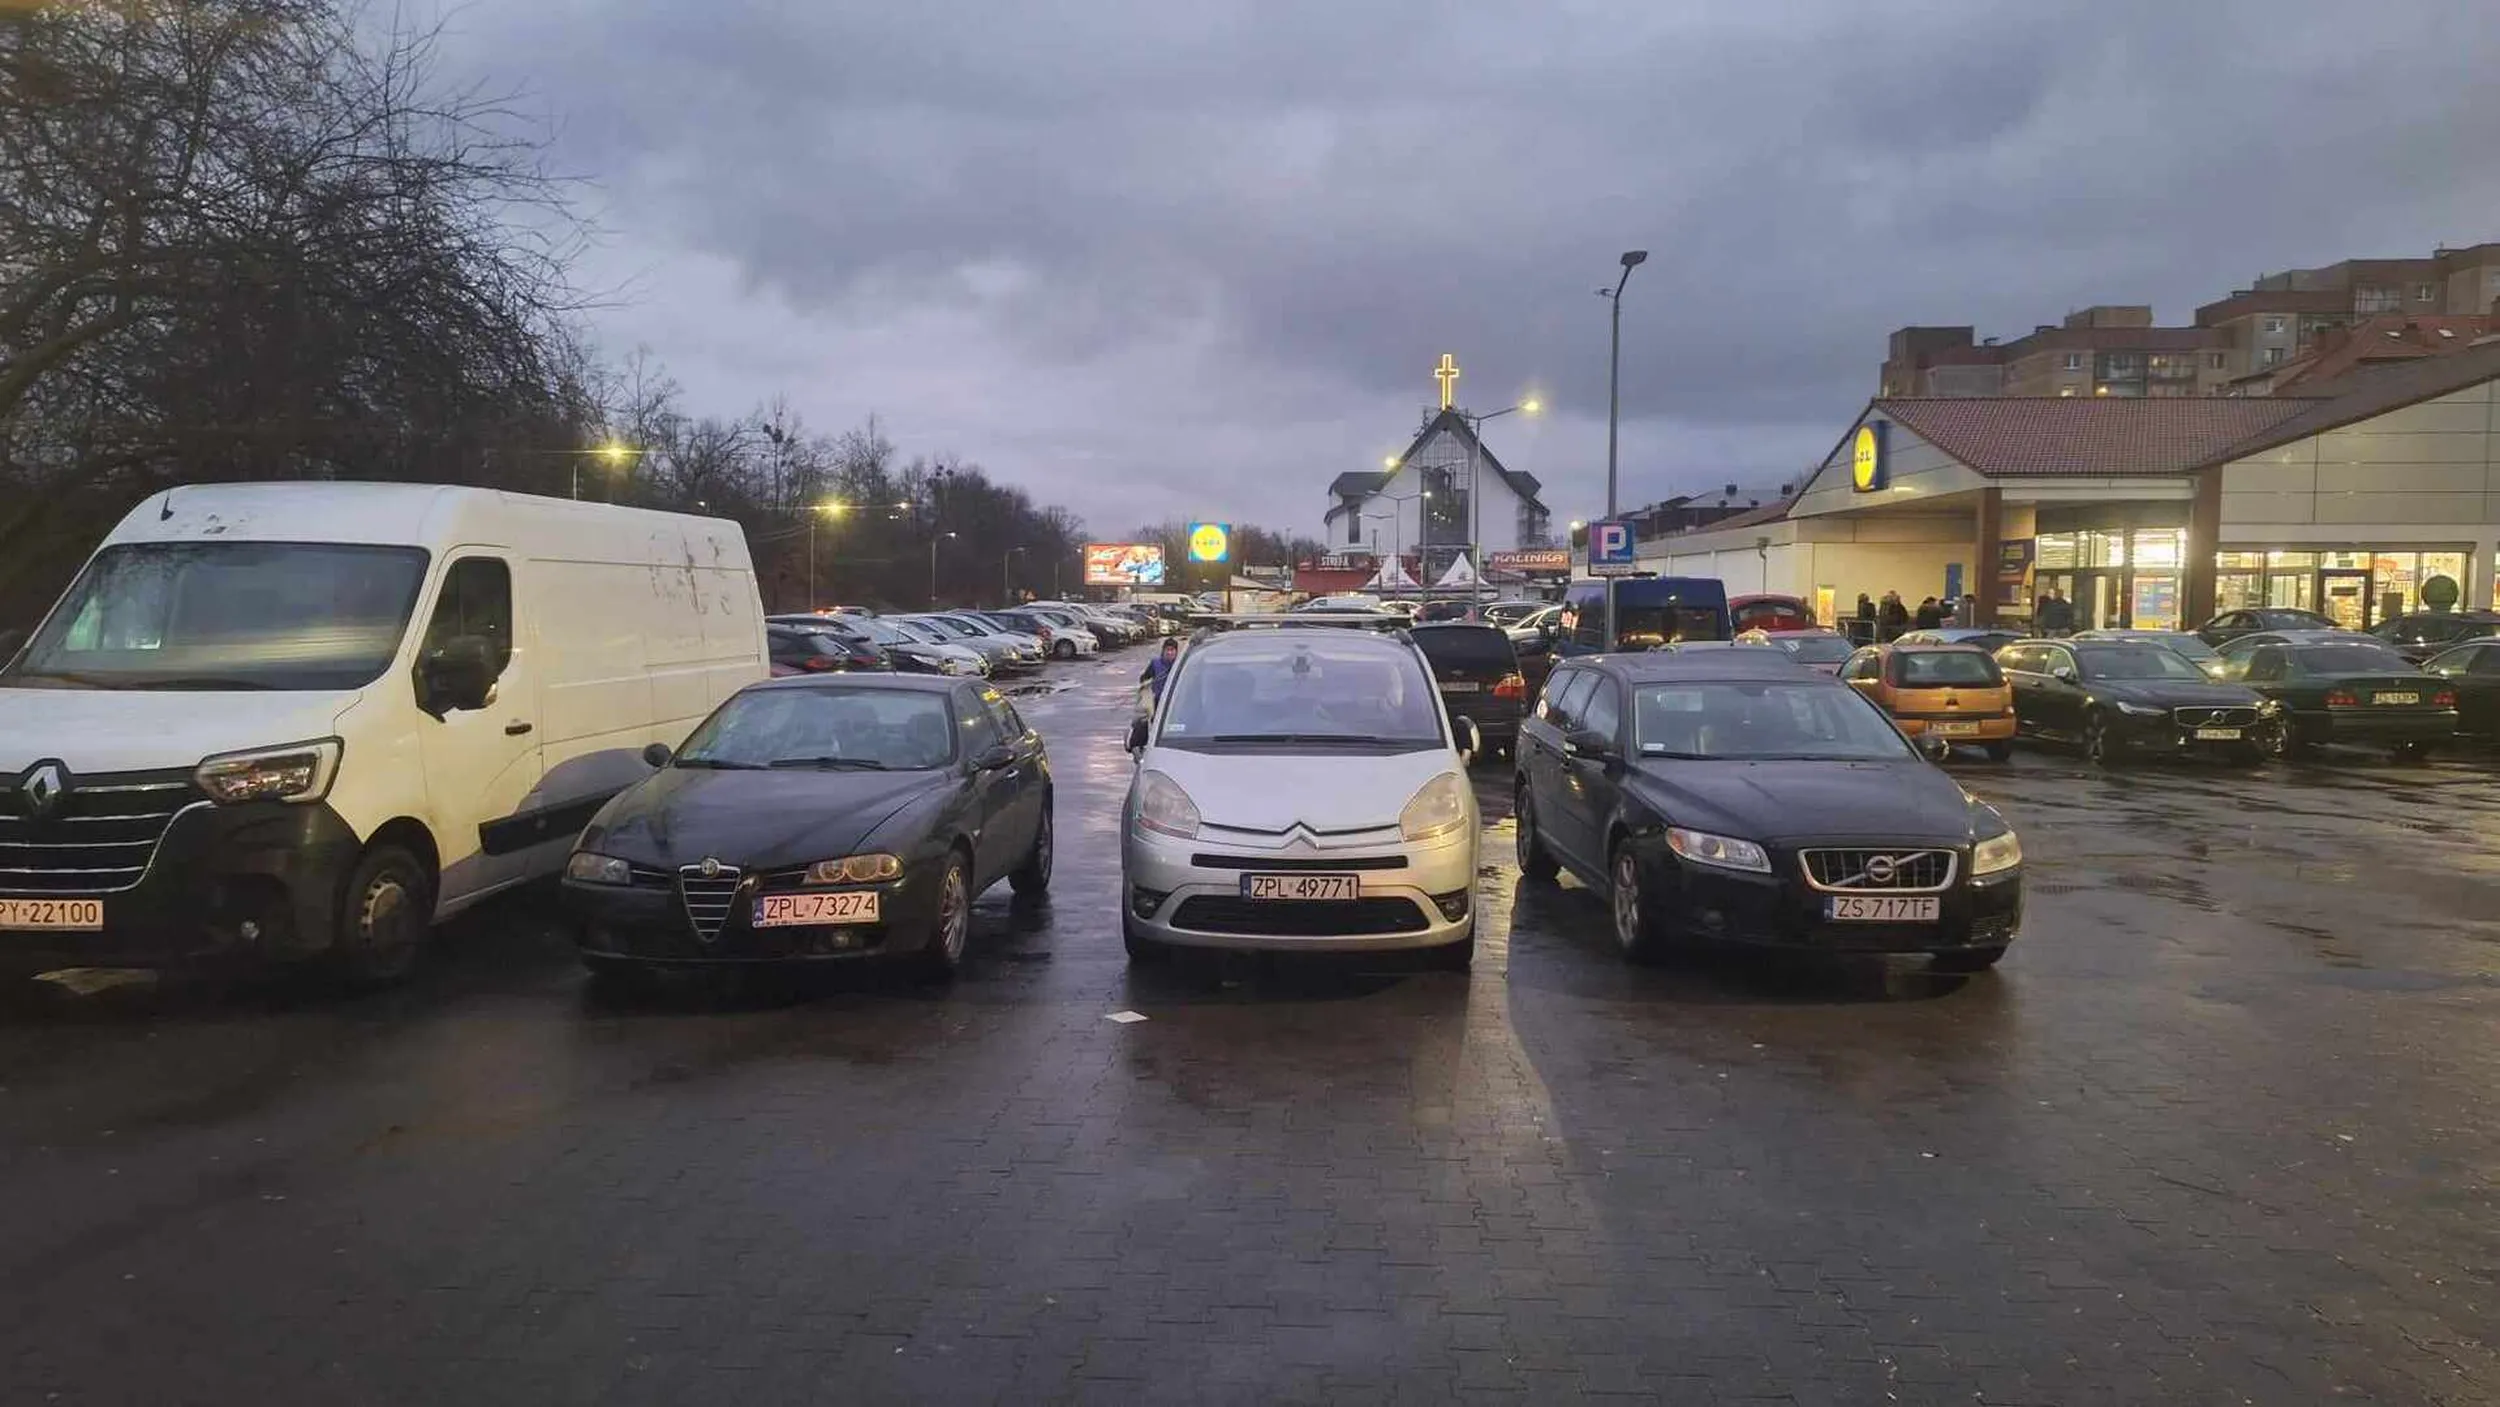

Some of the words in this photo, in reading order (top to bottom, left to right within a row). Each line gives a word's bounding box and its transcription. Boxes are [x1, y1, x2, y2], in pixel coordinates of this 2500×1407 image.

[1601, 526, 1626, 560] P
[1494, 554, 1564, 564] KALINKA
[1252, 878, 1288, 898] ZPL
[1296, 878, 1353, 898] 49771
[29, 902, 98, 923] 22100
[765, 898, 804, 919] ZPL
[812, 895, 876, 917] 73274
[1837, 899, 1864, 918] ZS
[1871, 900, 1933, 918] 717TF
